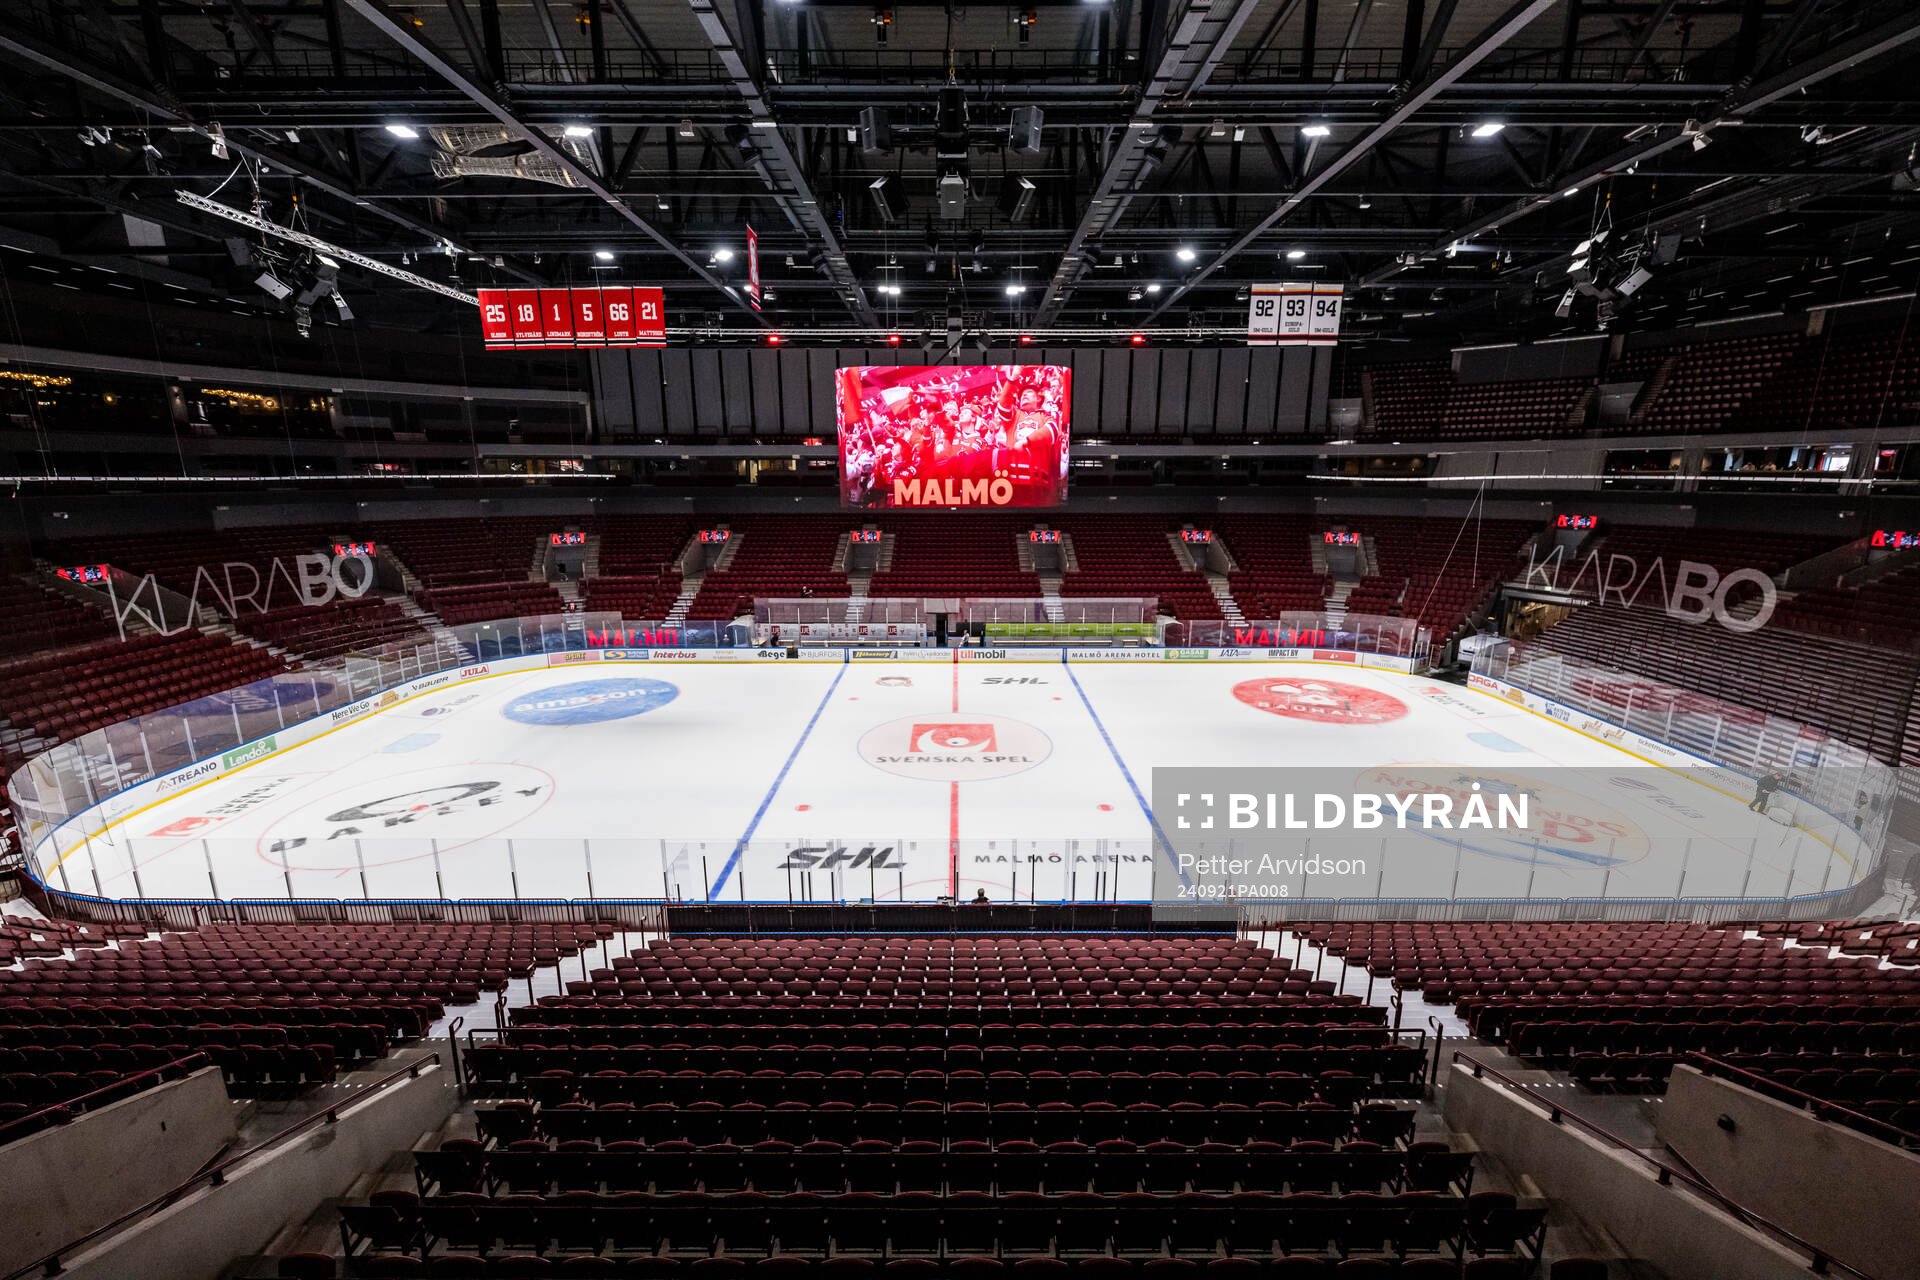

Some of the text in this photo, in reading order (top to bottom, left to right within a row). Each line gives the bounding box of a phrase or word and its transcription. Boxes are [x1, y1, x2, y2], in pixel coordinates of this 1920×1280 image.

[485, 305, 506, 322] 25
[517, 304, 534, 322] 18
[553, 304, 560, 321] 1
[582, 304, 593, 321] 5
[609, 303, 629, 321] 66
[641, 302, 658, 320] 21
[1255, 300, 1274, 317] 92
[1286, 300, 1305, 317] 93
[1316, 300, 1337, 317] 94
[894, 470, 1013, 505] MALMÖ
[653, 651, 697, 659] Interbus
[461, 666, 488, 677] JULA
[981, 677, 1048, 685] SHL
[332, 708, 348, 721] Here
[349, 706, 360, 715] We
[360, 701, 370, 712] Go
[1258, 702, 1385, 720] BAUHAUS
[170, 762, 217, 786] TREANO
[776, 846, 907, 869] SHL
[974, 852, 1153, 864] MALMÖ ARENA
